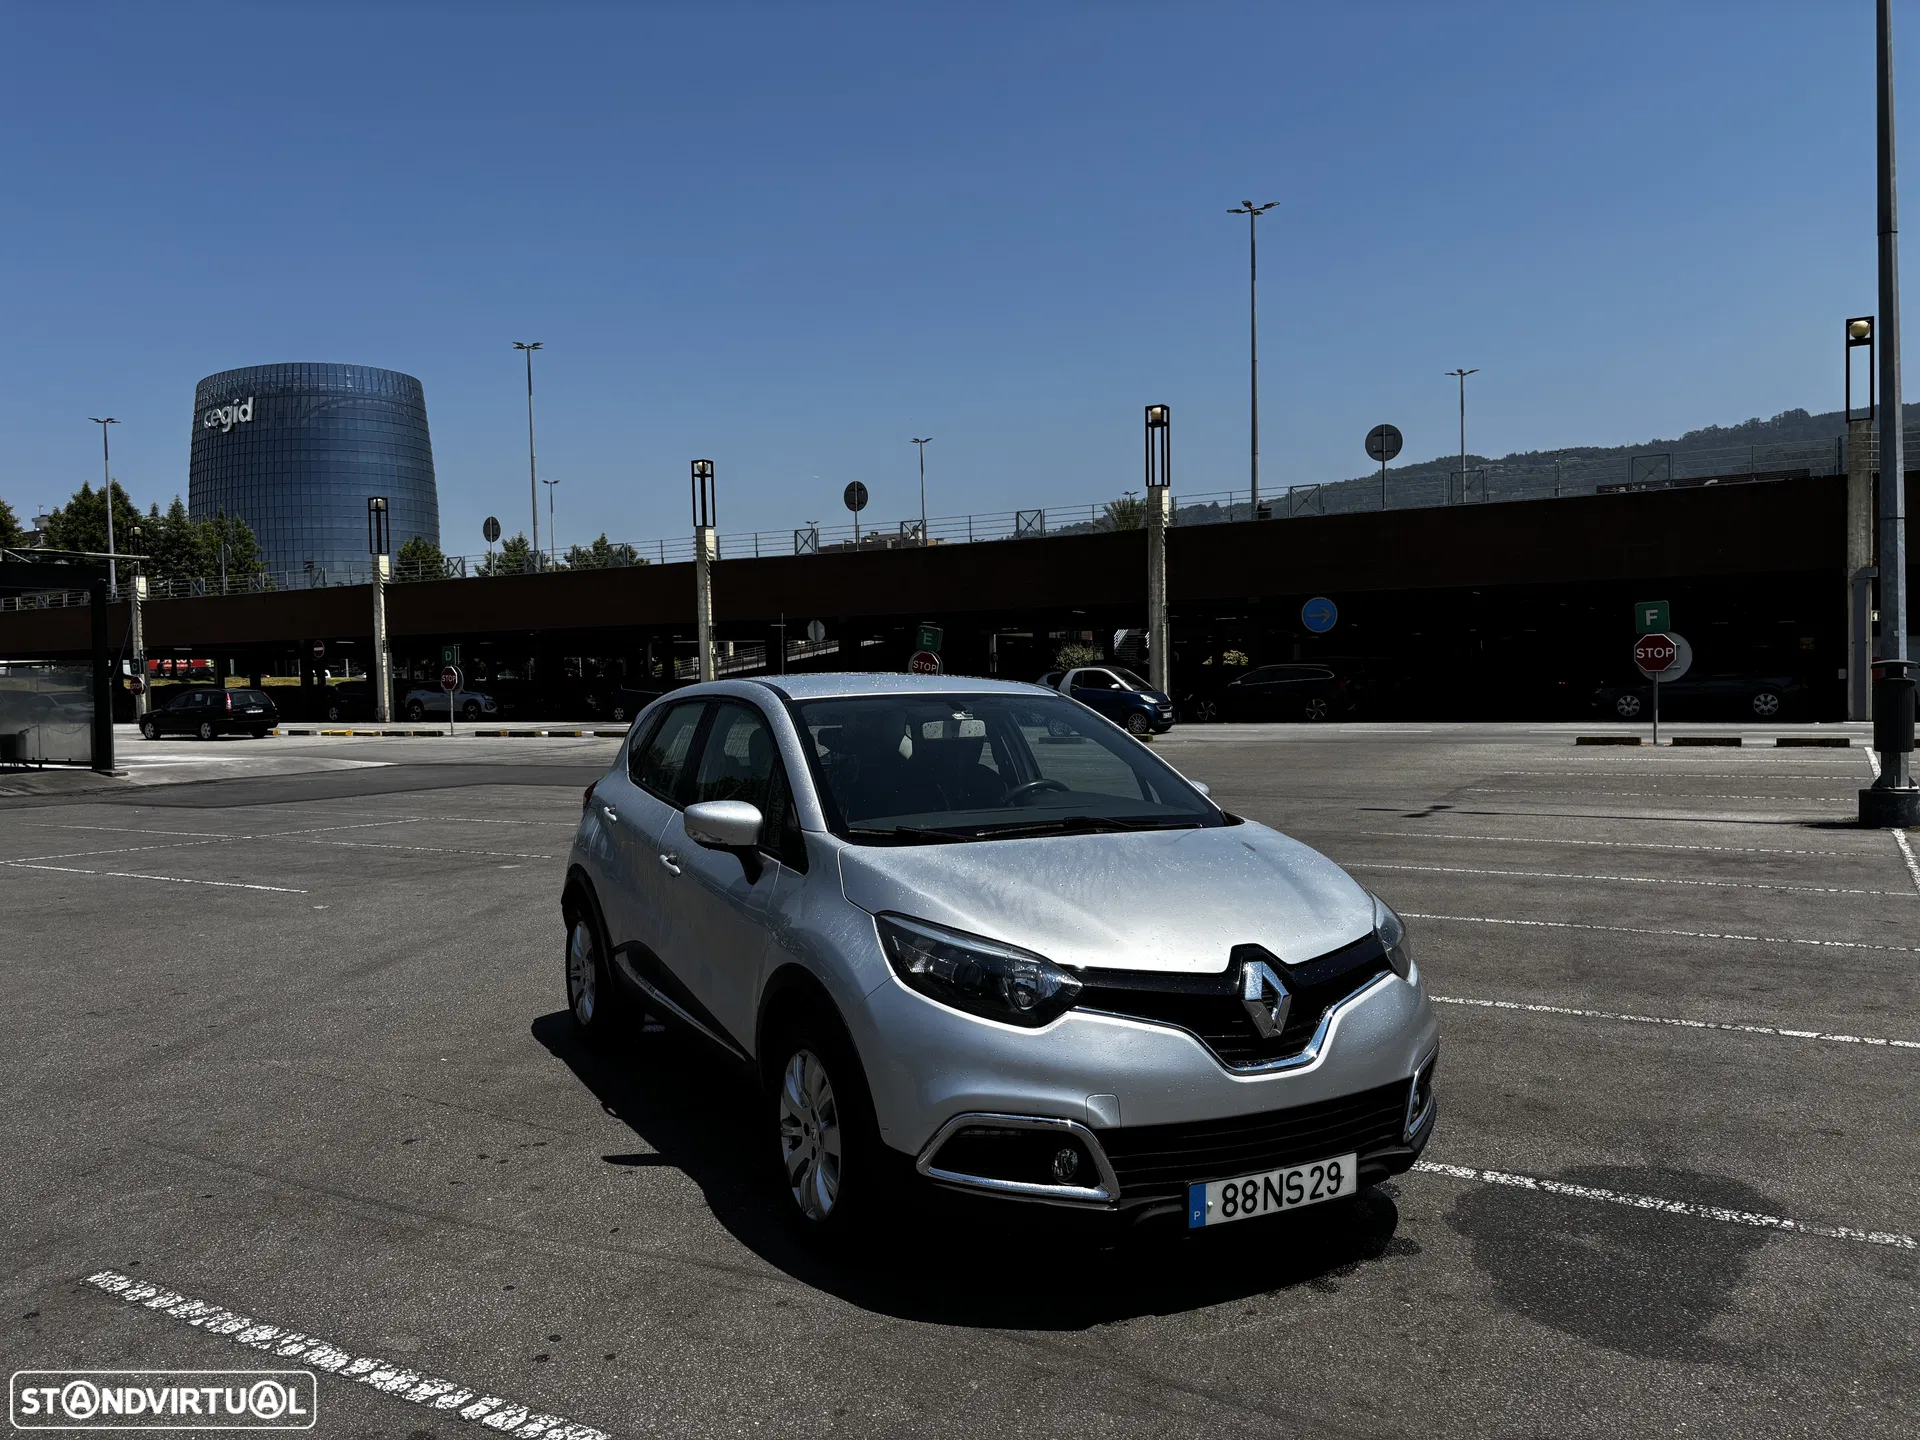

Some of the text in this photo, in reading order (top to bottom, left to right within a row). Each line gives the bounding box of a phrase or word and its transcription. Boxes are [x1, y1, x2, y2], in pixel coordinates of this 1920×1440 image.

[204, 397, 254, 432] cegid
[1645, 609, 1659, 626] F
[923, 632, 933, 645] E
[445, 651, 452, 661] D
[1636, 647, 1674, 659] STOP
[131, 662, 138, 671] C
[913, 660, 937, 672] STOP
[441, 674, 456, 682] STOP
[1193, 1210, 1201, 1221] P
